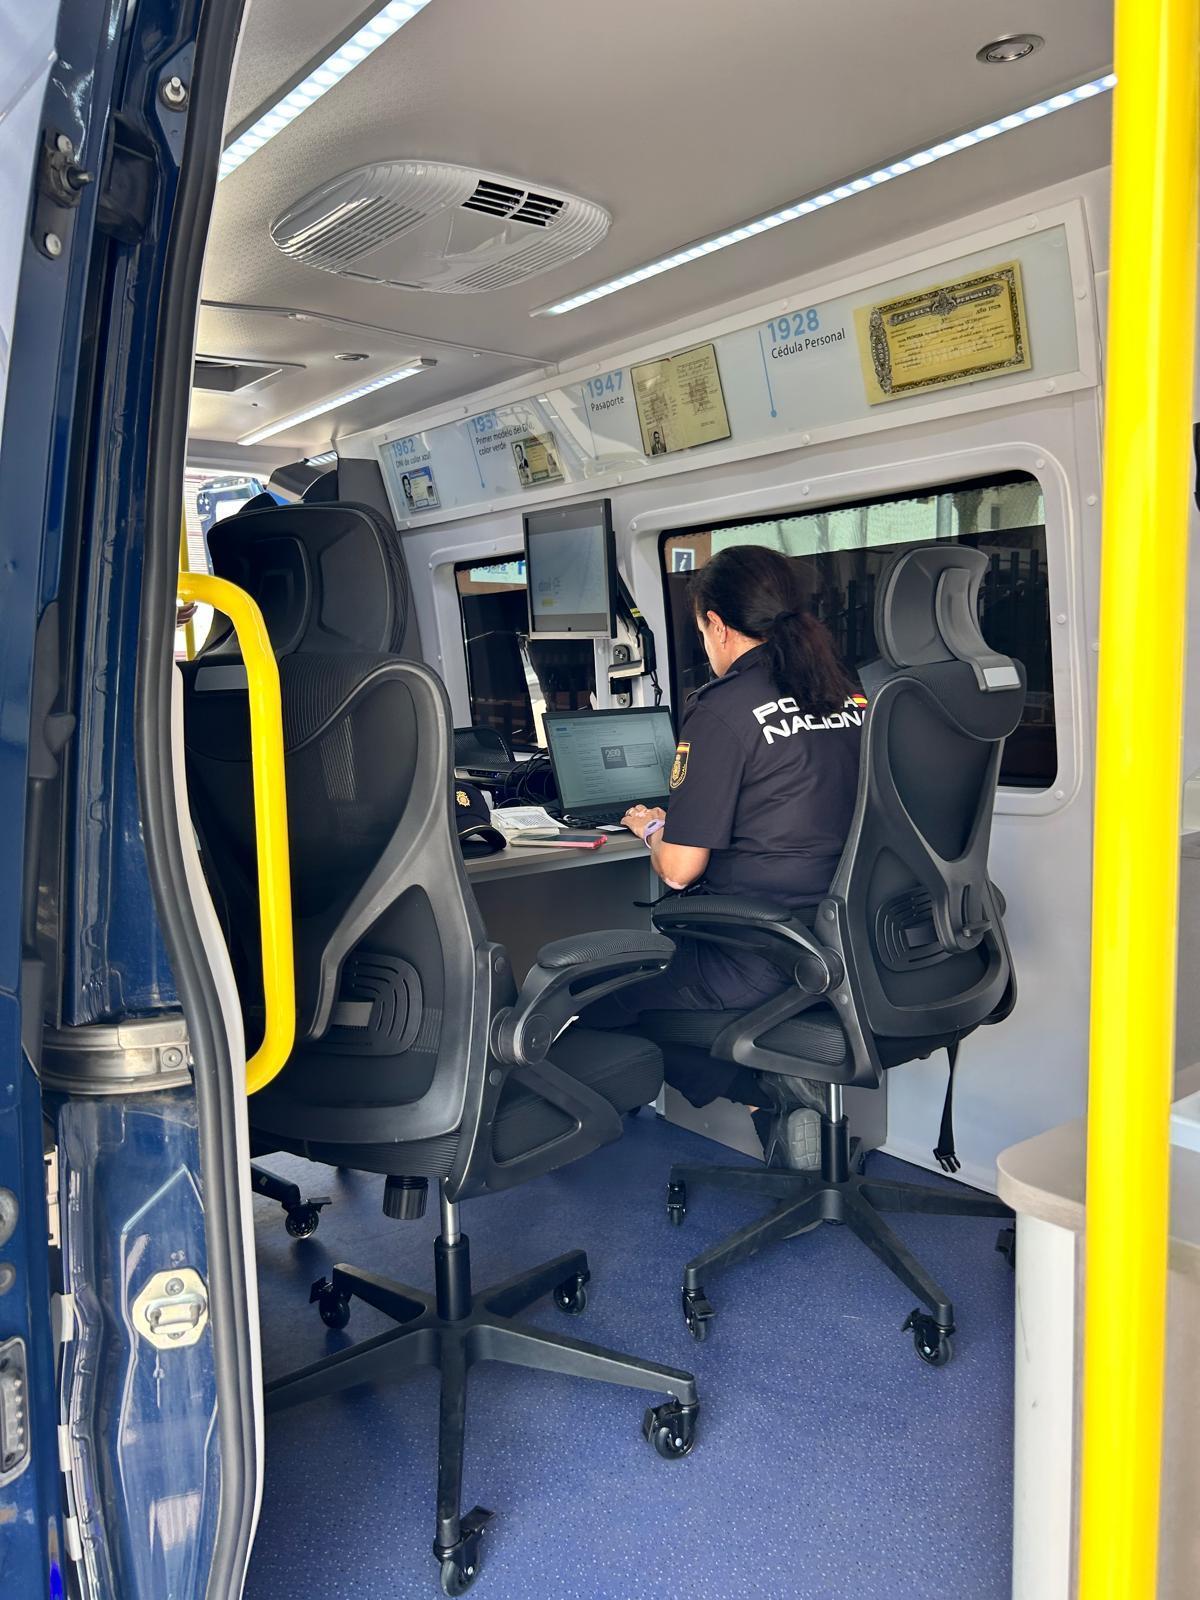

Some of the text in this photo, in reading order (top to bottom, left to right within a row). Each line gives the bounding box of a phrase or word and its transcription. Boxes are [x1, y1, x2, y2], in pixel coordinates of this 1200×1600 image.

[767, 308, 820, 343] 1928
[771, 327, 846, 359] Cédula Personal
[587, 371, 622, 398] 1947
[590, 396, 625, 411] Pasaporte
[475, 434, 493, 445] Primer
[493, 425, 512, 440] modelo
[512, 423, 521, 435] del
[392, 438, 416, 457] 1962
[478, 441, 506, 456] color verde
[762, 709, 866, 745] NACION
